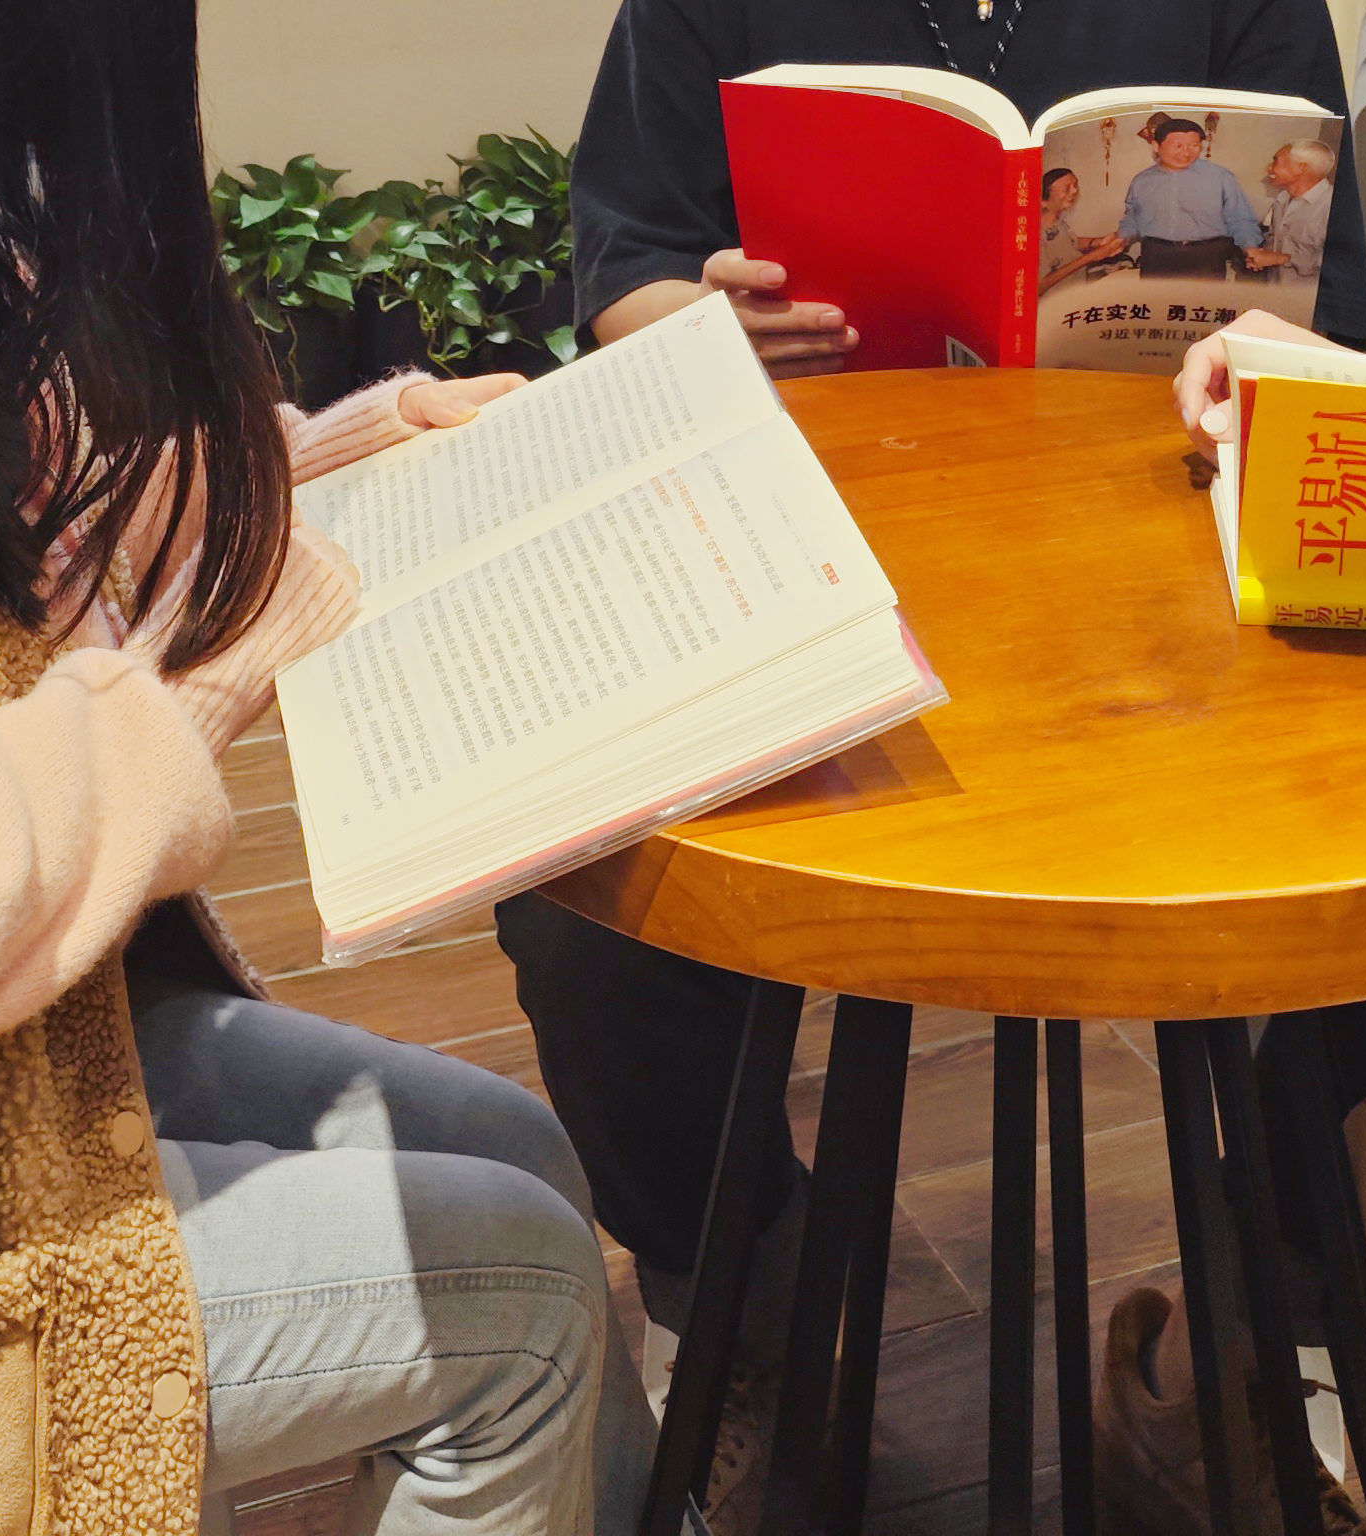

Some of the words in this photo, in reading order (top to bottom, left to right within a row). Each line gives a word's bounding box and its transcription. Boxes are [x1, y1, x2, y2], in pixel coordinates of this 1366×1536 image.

[1061, 303, 1152, 330] 干在实处
[1166, 304, 1241, 326] 勇立潮
